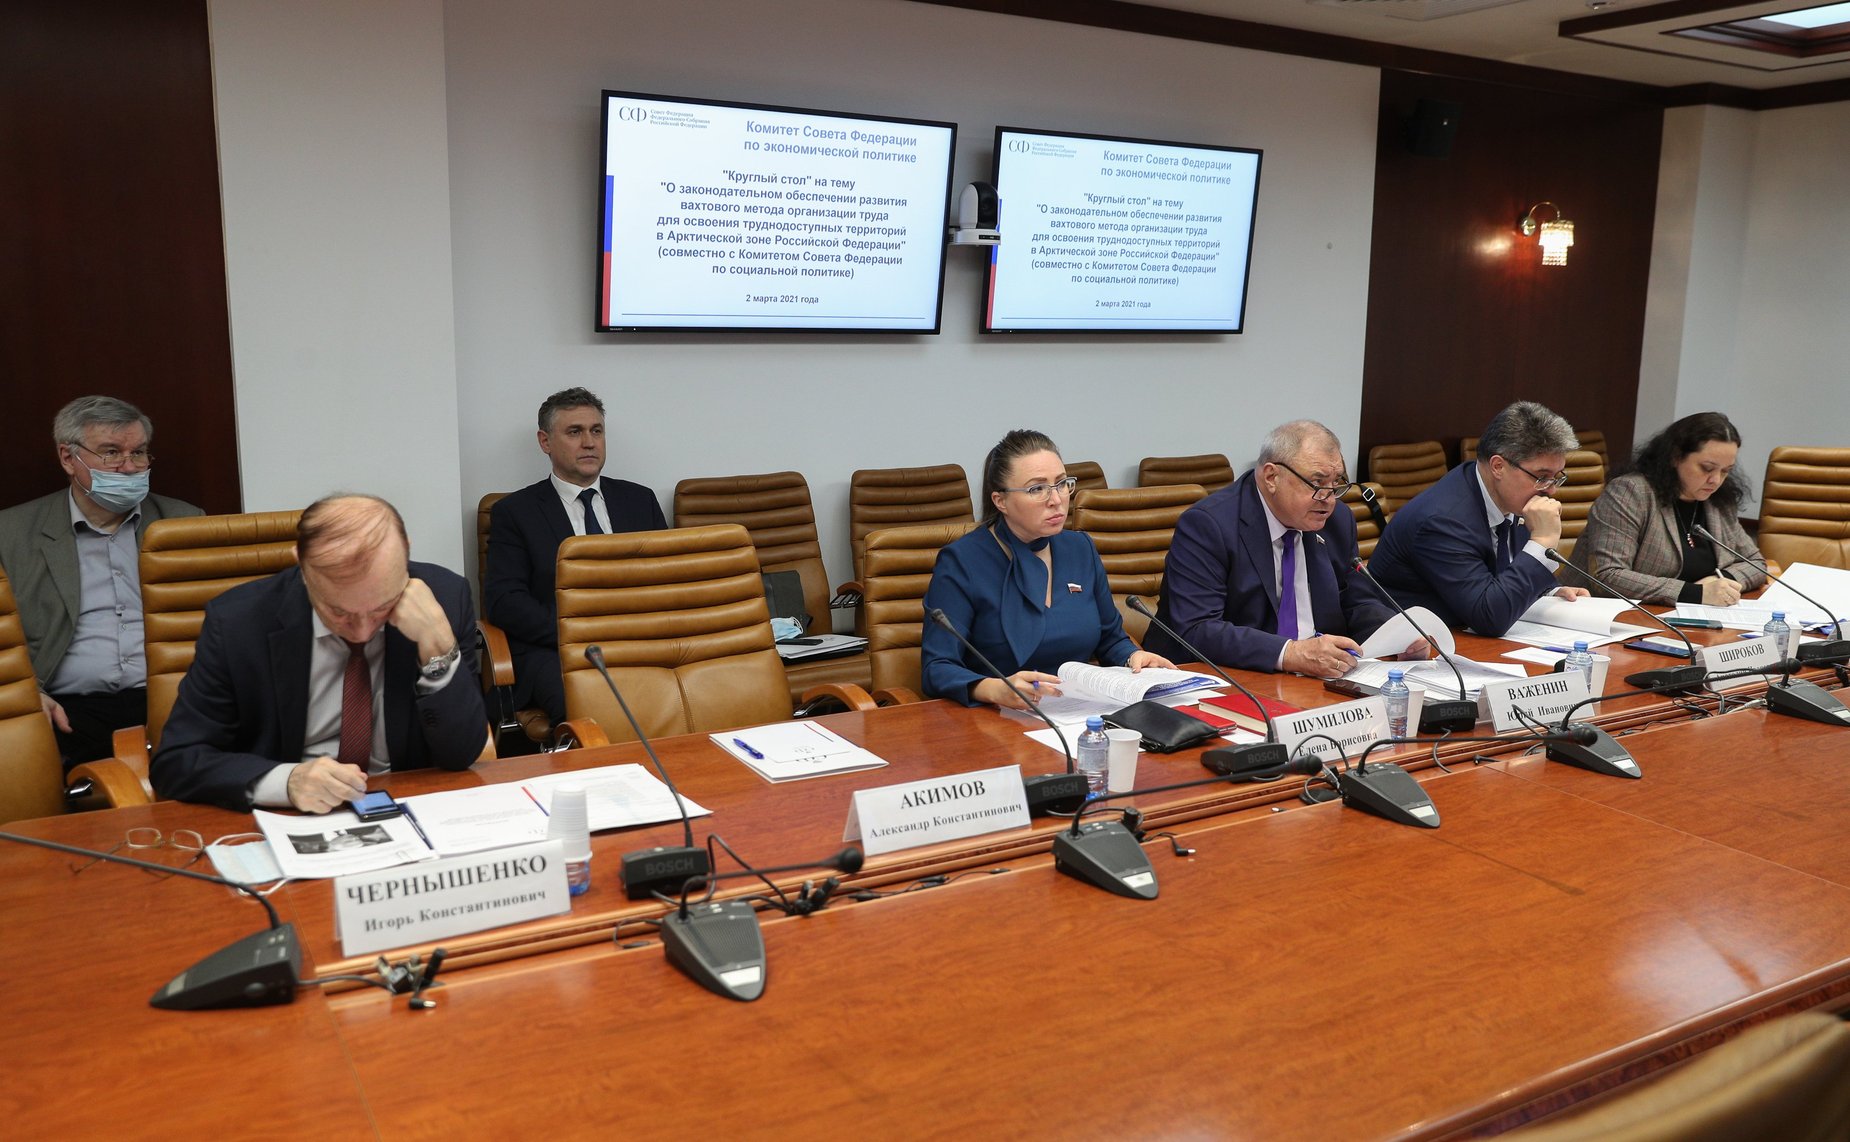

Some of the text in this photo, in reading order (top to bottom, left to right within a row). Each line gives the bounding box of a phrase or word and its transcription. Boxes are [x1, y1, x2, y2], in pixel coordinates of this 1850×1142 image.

[619, 106, 647, 122] СФ
[746, 120, 917, 147] Комитет Совета Федерации
[744, 141, 917, 163] по экономической политике
[1009, 139, 1030, 153] СФ
[1103, 150, 1232, 170] Комитет Совета Федерации
[722, 170, 856, 191] "Круглый стол" на тему
[1101, 168, 1231, 185] по экономической политике
[660, 181, 907, 207] "О законодательном обеспечении развития
[1083, 193, 1184, 210] "Круглый стол" на тему
[680, 201, 889, 222] вахтового метода организации труда
[1036, 204, 1222, 223] "О законодательном обеспечении развития
[656, 216, 906, 238] для освоения труднодоступных территорий
[1050, 220, 1208, 237] вахтового метода организации труда
[656, 230, 906, 252] в Арктической зоне Российской Федерации"
[1031, 233, 1220, 250] для освоения труднодоступных территорий
[658, 246, 903, 266] (совместно с Комитетом Совета Федерации
[1038, 245, 1096, 257] Арктической
[1098, 249, 1118, 258] зоне
[1120, 248, 1169, 259] Российской
[1170, 251, 1220, 262] Федерации"
[712, 265, 854, 280] по социальной политике)
[1031, 259, 1216, 275] (совместно с Комитетом Совета Федерации
[1071, 275, 1179, 287] по социальной политике)
[746, 294, 819, 305] 2 марта 2021 года
[1101, 301, 1120, 309] марта
[1121, 300, 1136, 308] 2021
[1719, 644, 1764, 662] ШИРОКОВ
[1507, 680, 1568, 700] ВАЖЕНИН
[1440, 706, 1470, 717] BOSCH
[1538, 704, 1577, 716] Иванови
[1293, 707, 1373, 734] ШУМИЛОВА
[1248, 750, 1279, 764] BOSCH
[1298, 744, 1327, 757] Елена
[900, 780, 986, 809] АКИМОВ
[1042, 782, 1078, 797] BOSCH
[870, 804, 1022, 839] Александр Константинович
[645, 858, 694, 876] BOSCH
[348, 854, 547, 904] ЧЕРНЫШЕНКО
[365, 891, 546, 932] Игорь Константинович
